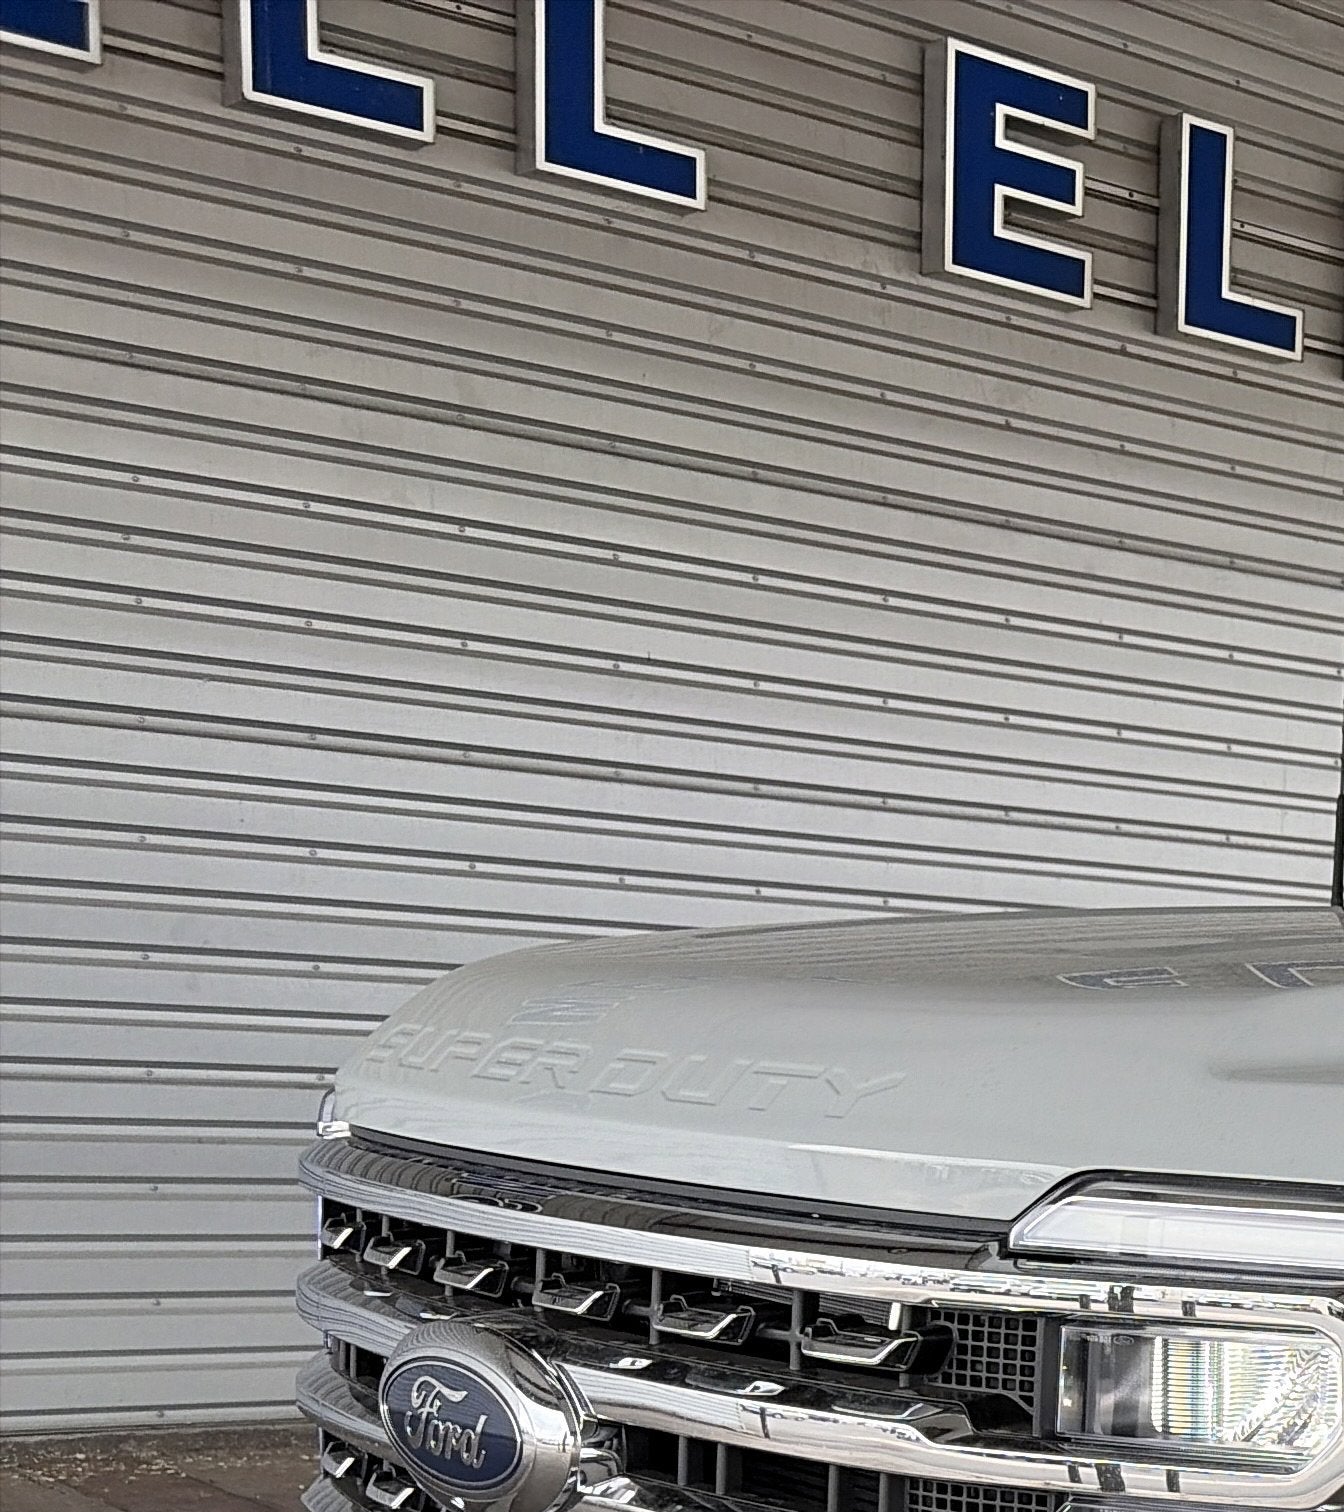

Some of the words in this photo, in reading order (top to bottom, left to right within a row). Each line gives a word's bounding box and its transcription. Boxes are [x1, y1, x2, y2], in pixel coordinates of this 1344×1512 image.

[361, 1024, 595, 1090] SUPER
[589, 1046, 908, 1120] DUTY
[403, 1374, 488, 1469] Ford
